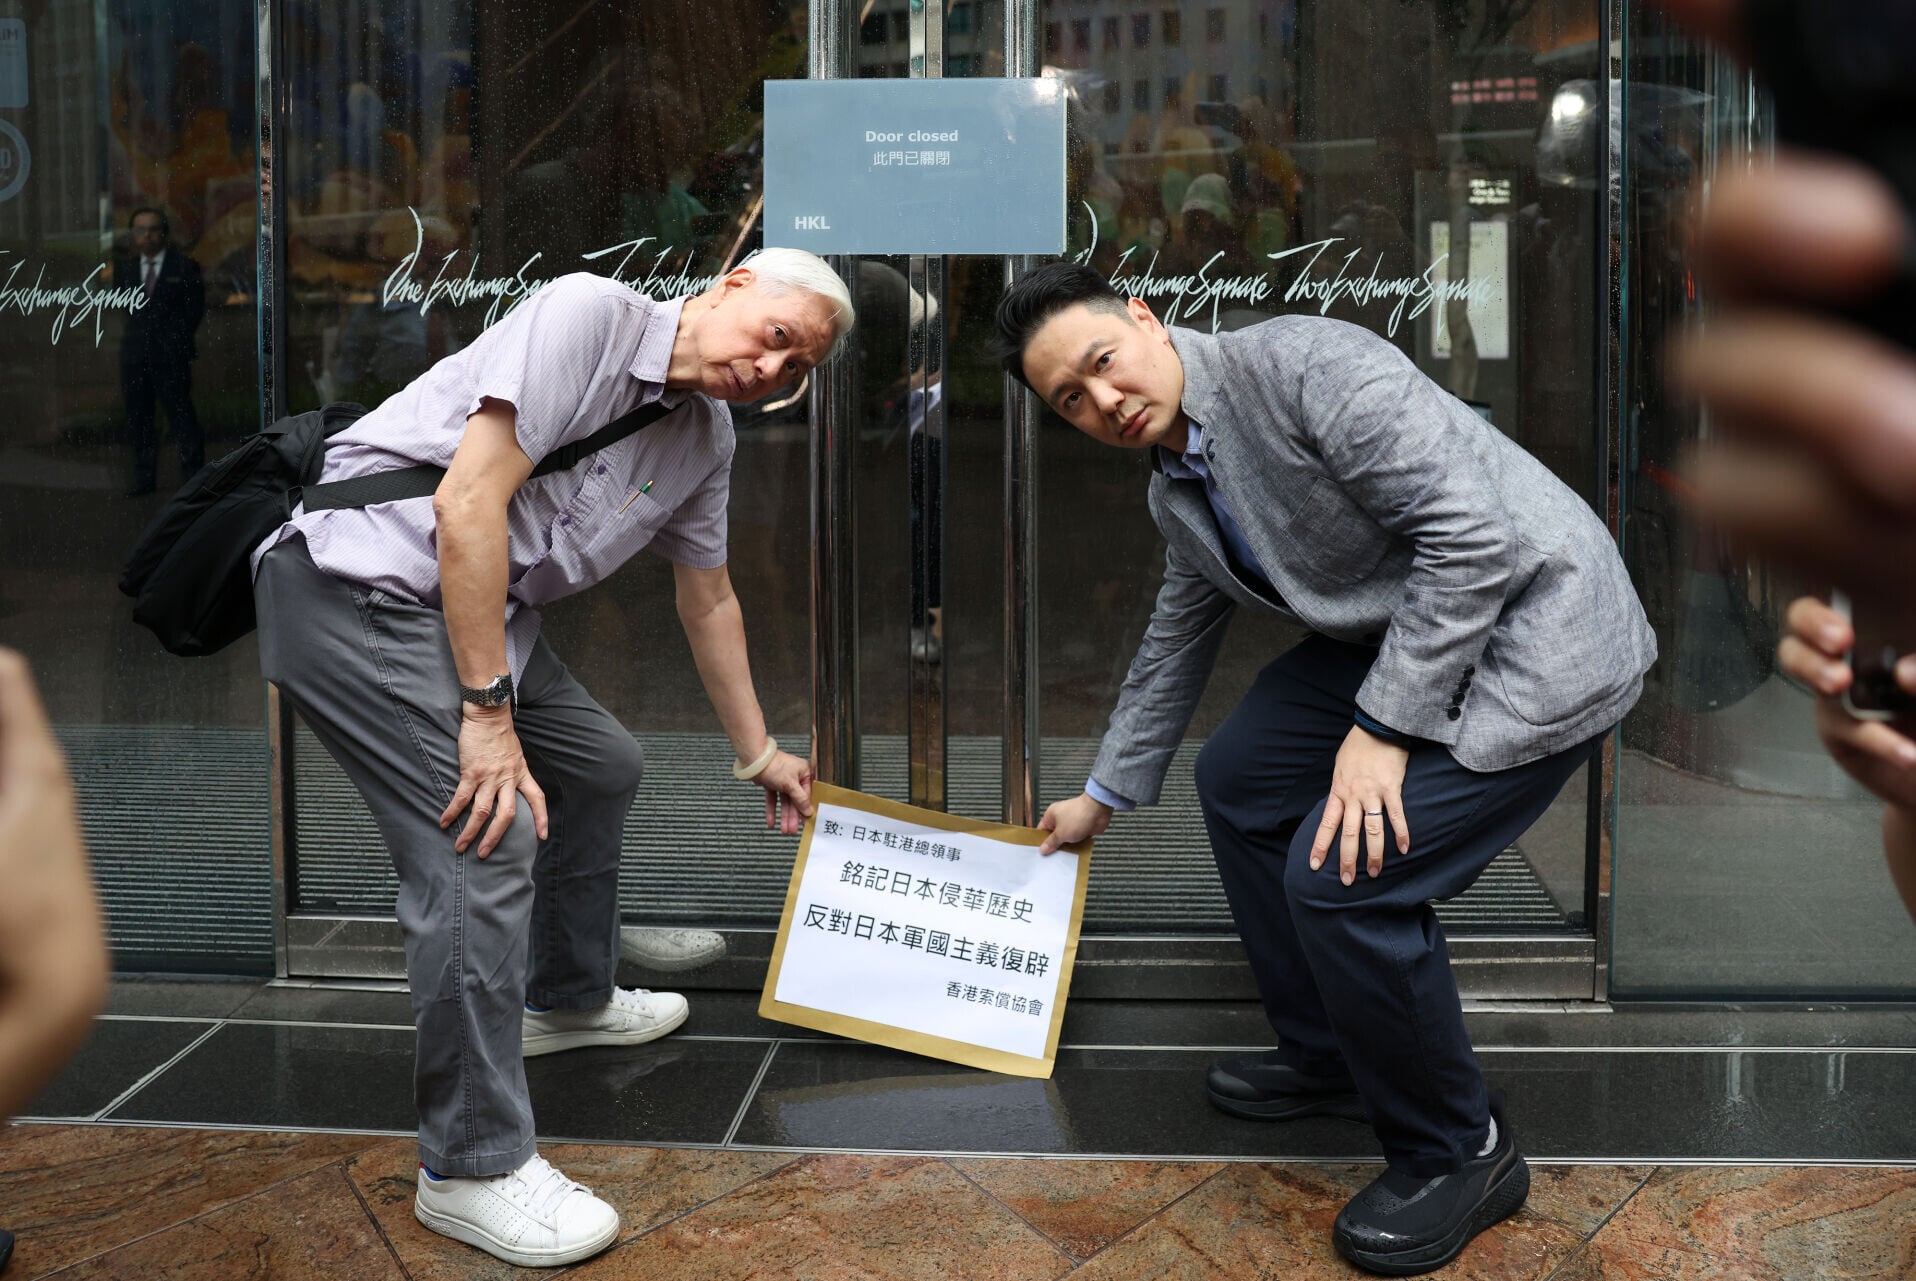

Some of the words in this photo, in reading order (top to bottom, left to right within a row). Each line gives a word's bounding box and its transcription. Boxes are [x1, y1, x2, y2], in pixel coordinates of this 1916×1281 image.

[865, 130, 903, 143] Door
[908, 130, 959, 143] closed
[873, 150, 951, 167] 此門已關閉
[794, 216, 831, 231] HKL
[852, 825, 962, 862] 日本駐港總領事
[839, 860, 1035, 924] 銘記日本侵華歷史
[803, 903, 1051, 978] 反對日本軍國主義復辟
[946, 980, 1045, 1017] 香港索償協會
